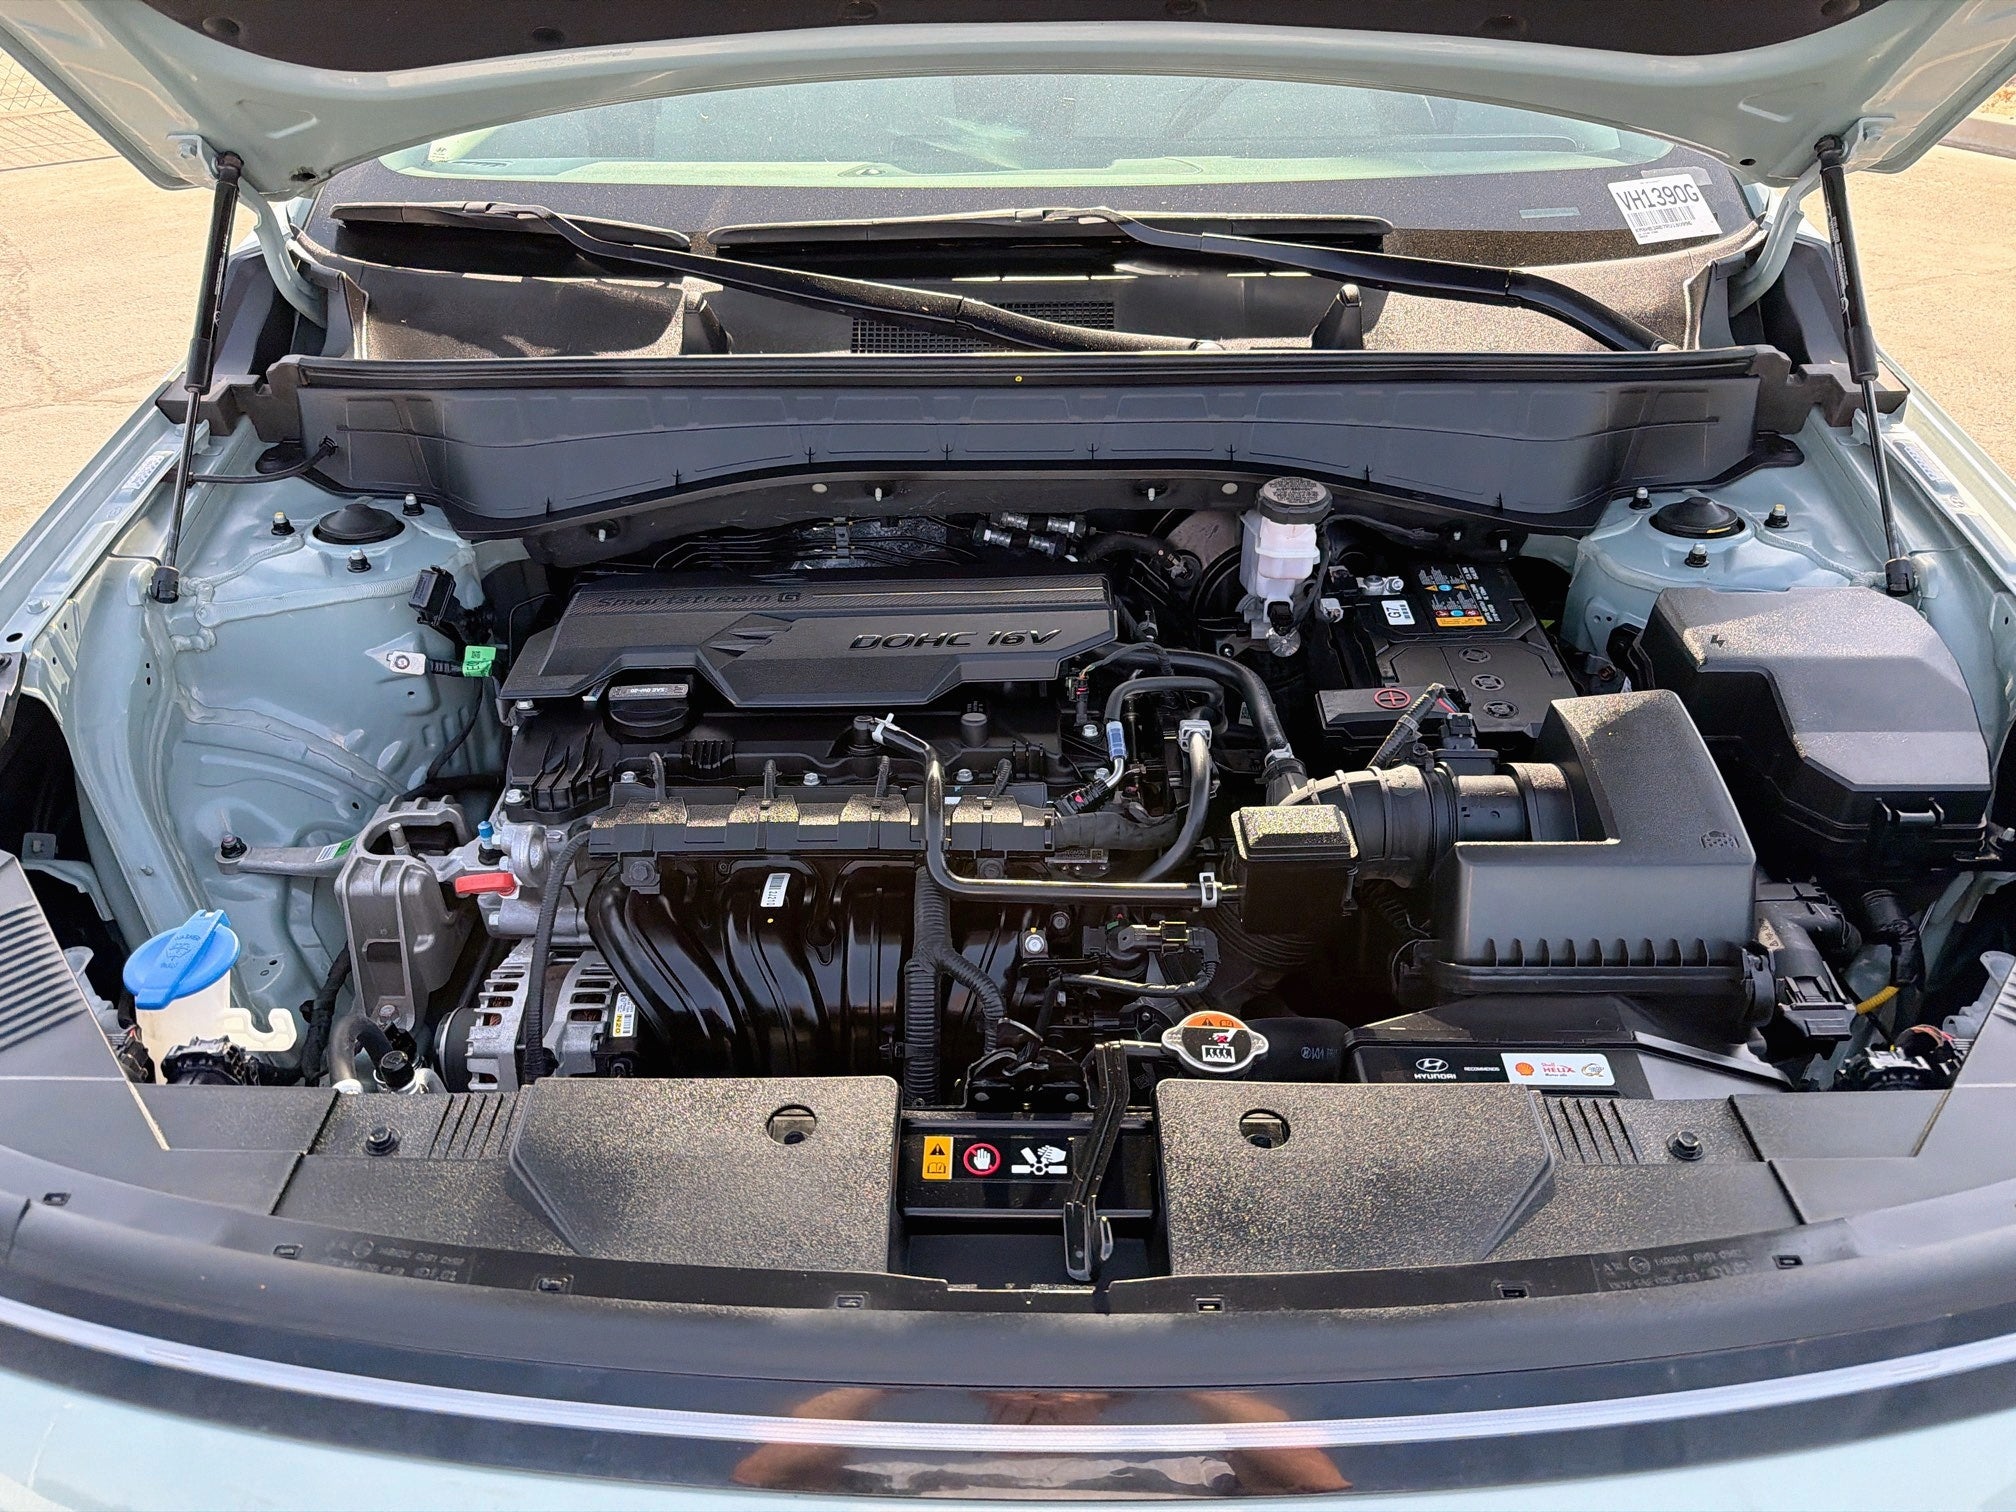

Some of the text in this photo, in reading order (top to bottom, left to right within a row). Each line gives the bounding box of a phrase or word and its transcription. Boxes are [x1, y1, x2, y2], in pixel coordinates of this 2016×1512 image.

[1616, 184, 1699, 211] VH1390G
[1386, 607, 1401, 618] G7
[850, 629, 1062, 650] DOHC 16V
[1542, 1066, 1576, 1074] HELIX
